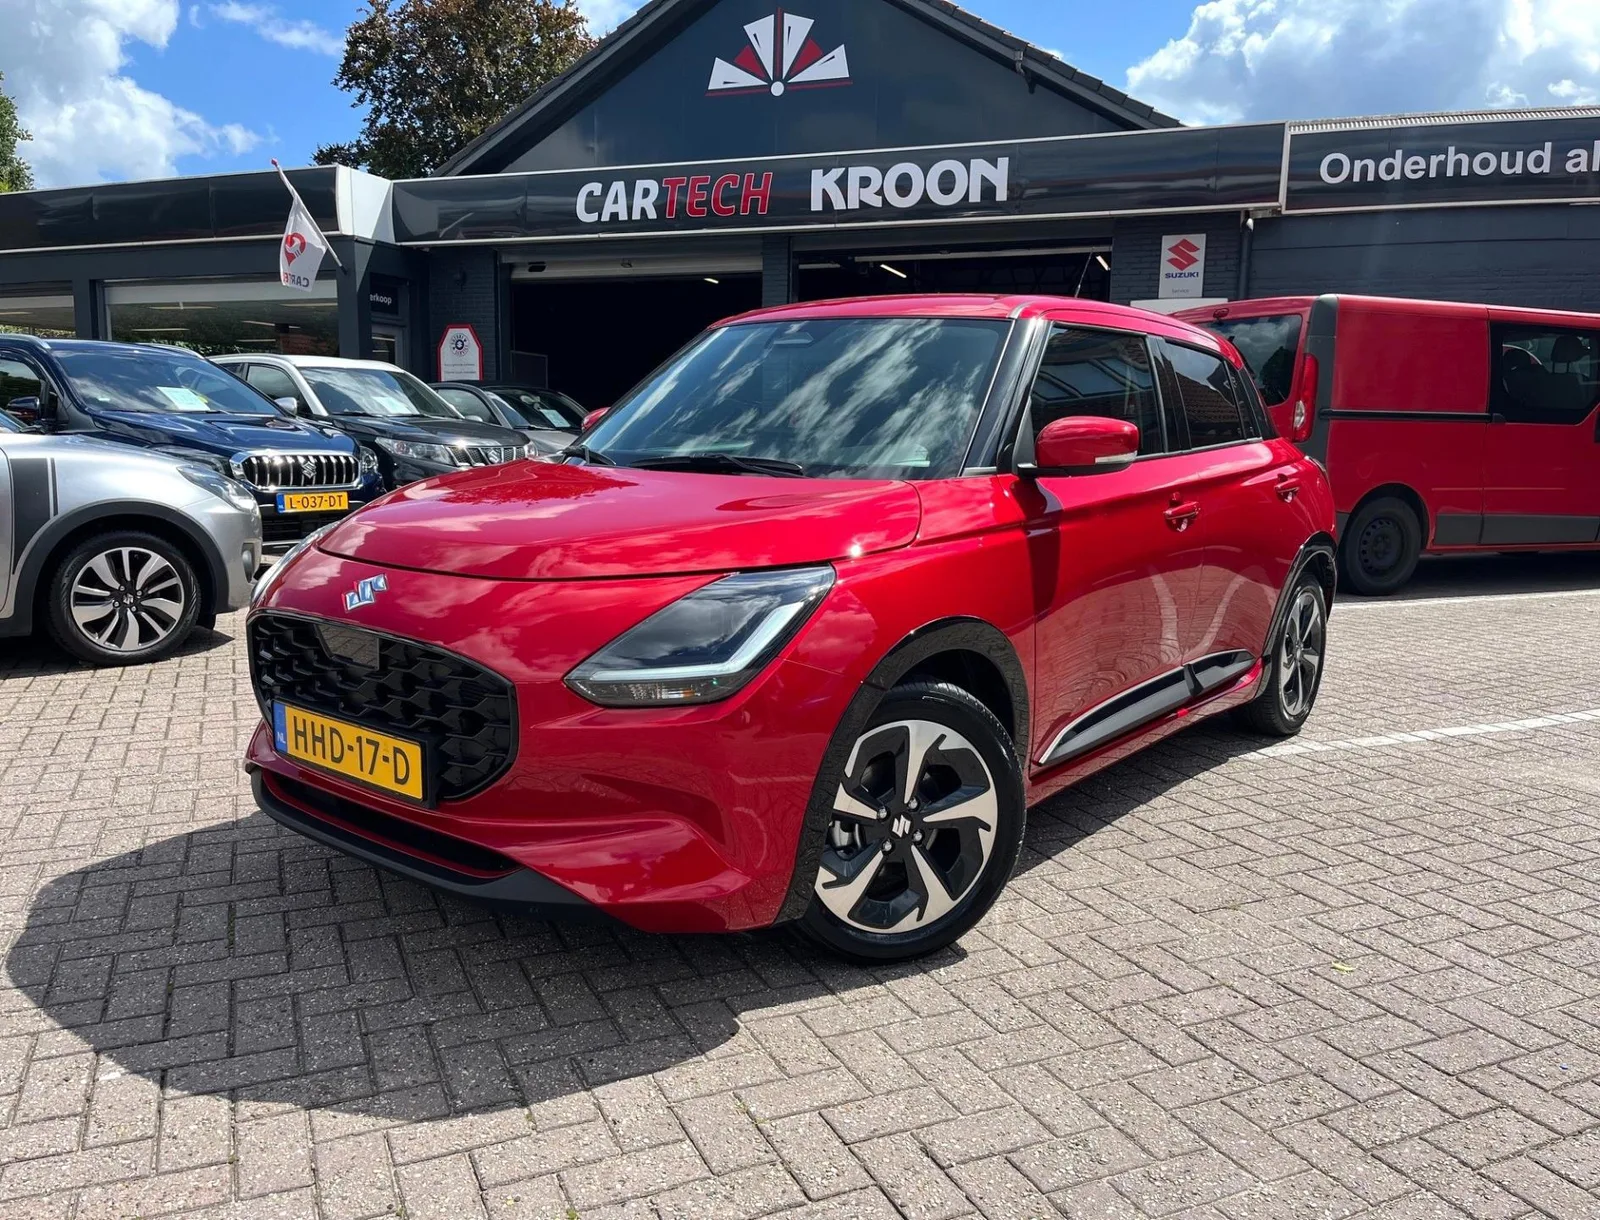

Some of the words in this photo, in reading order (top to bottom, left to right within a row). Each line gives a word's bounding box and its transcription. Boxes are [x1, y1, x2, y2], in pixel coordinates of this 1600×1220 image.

[1319, 142, 1552, 184] Onderhoud
[575, 171, 773, 223] CARTECH
[810, 157, 1009, 212] KROON
[1165, 271, 1199, 279] SUZUKI
[289, 494, 343, 509] L-037-DT
[276, 732, 286, 744] NL
[293, 715, 410, 785] HHD-17-D
